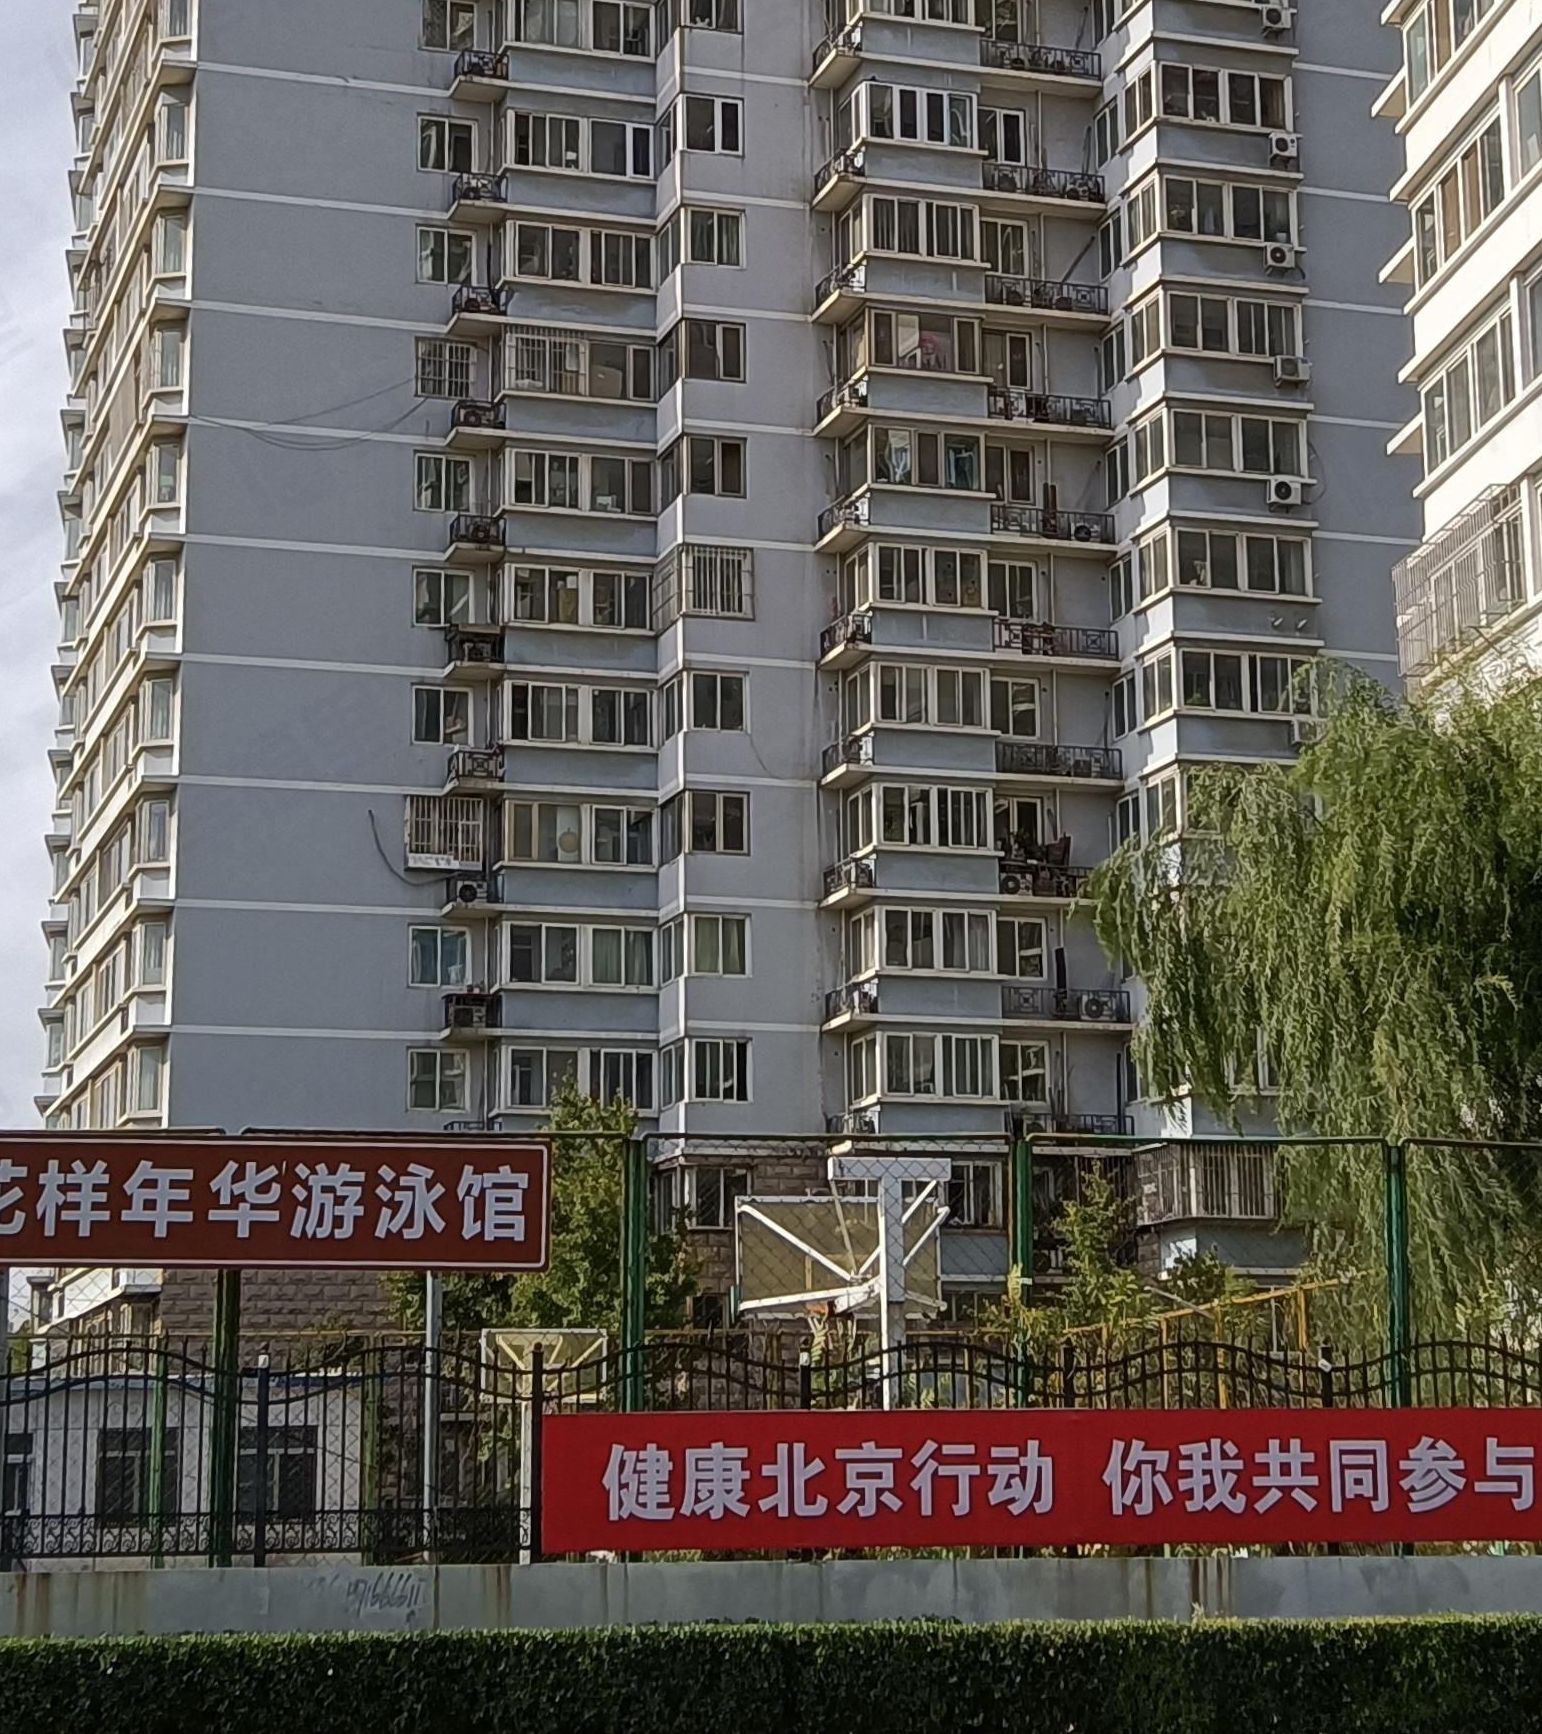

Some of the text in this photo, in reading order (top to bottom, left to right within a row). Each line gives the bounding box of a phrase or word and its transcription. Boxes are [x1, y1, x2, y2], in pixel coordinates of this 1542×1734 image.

[601, 1435, 1538, 1521] 健康北京行动 你我共同参与
